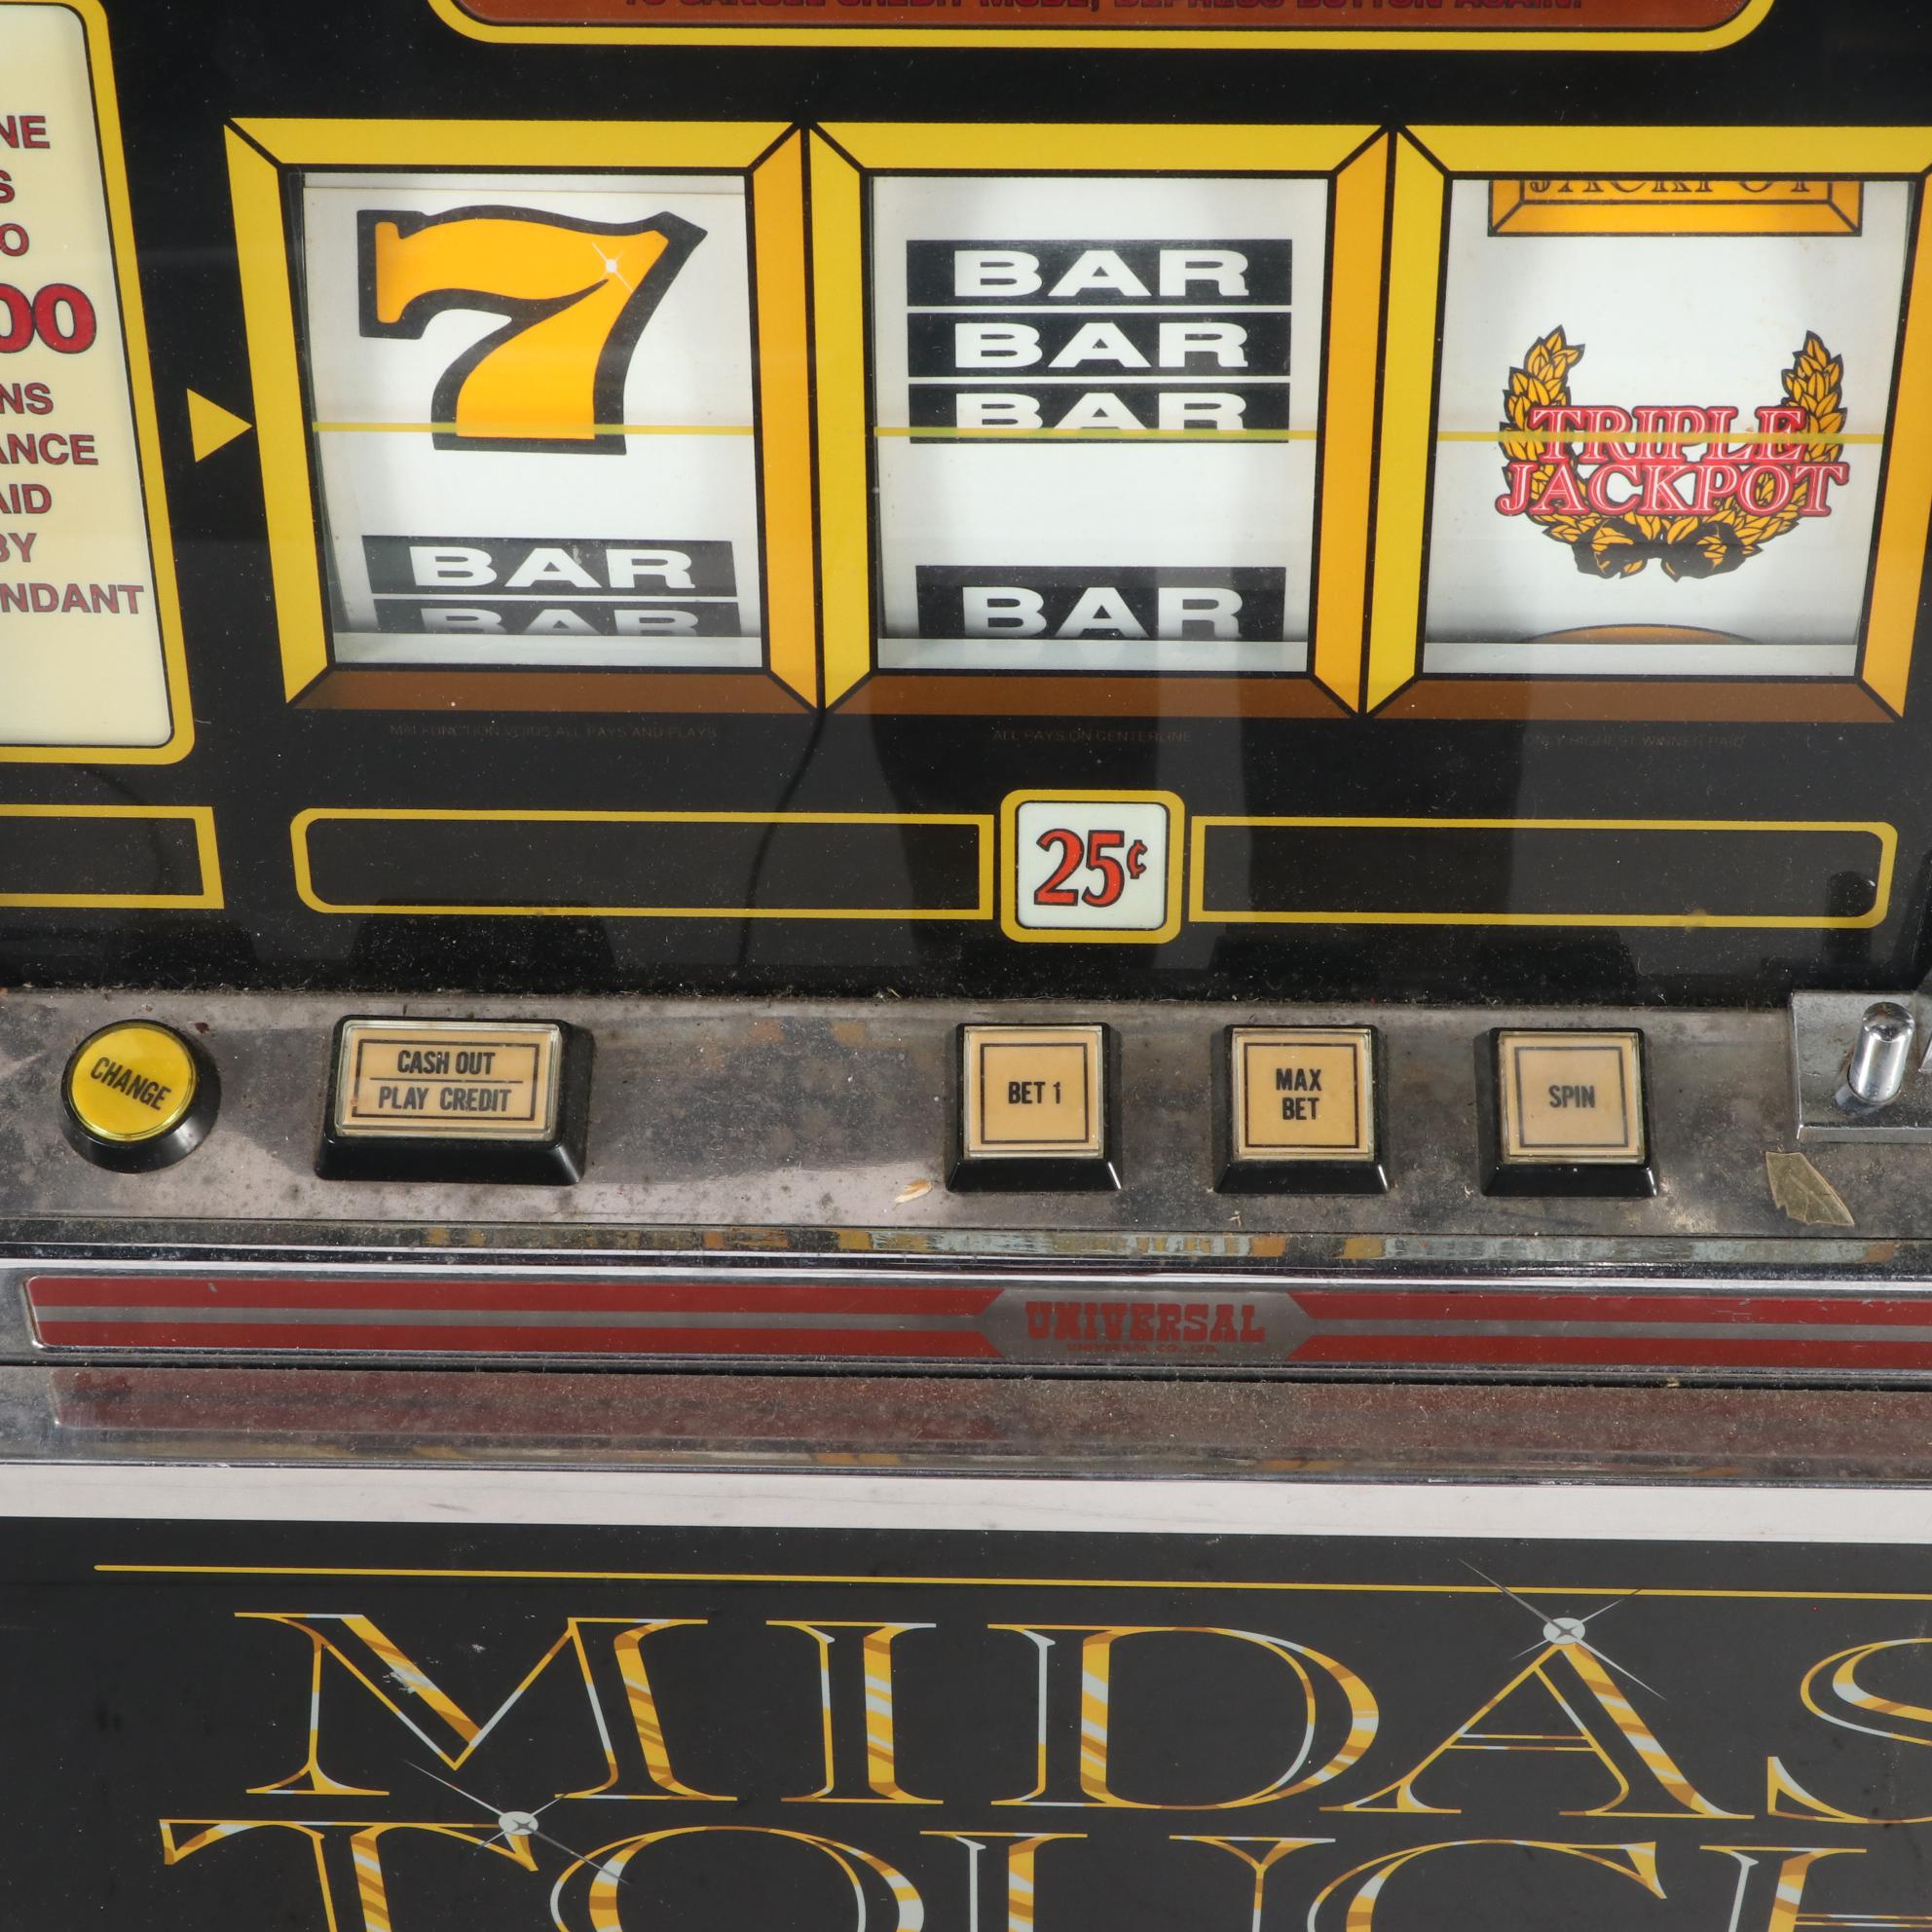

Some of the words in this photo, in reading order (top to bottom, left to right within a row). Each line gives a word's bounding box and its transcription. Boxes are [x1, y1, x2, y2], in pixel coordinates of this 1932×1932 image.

[954, 249, 1249, 297] BAR
[356, 204, 708, 455] 7
[954, 321, 1248, 368] BAR
[955, 392, 1246, 438] BAR
[1530, 406, 1807, 463] TRIPLE
[1495, 461, 1849, 517] JACKPOT
[408, 545, 695, 589] BAR
[961, 586, 1244, 639] BAR
[1033, 828, 1147, 907] 25¢
[90, 1056, 171, 1111] CHANGE
[397, 1049, 449, 1075] CASH
[455, 1051, 496, 1076] OUT
[1276, 1067, 1321, 1092] MAX
[378, 1086, 427, 1110] PLAY
[439, 1088, 512, 1112] CREDIT
[1008, 1080, 1044, 1105] BET
[1052, 1080, 1061, 1105] 1
[1282, 1096, 1320, 1121] BET
[1548, 1084, 1596, 1109] SPIN
[1024, 1300, 1266, 1343] UNIVERSAL
